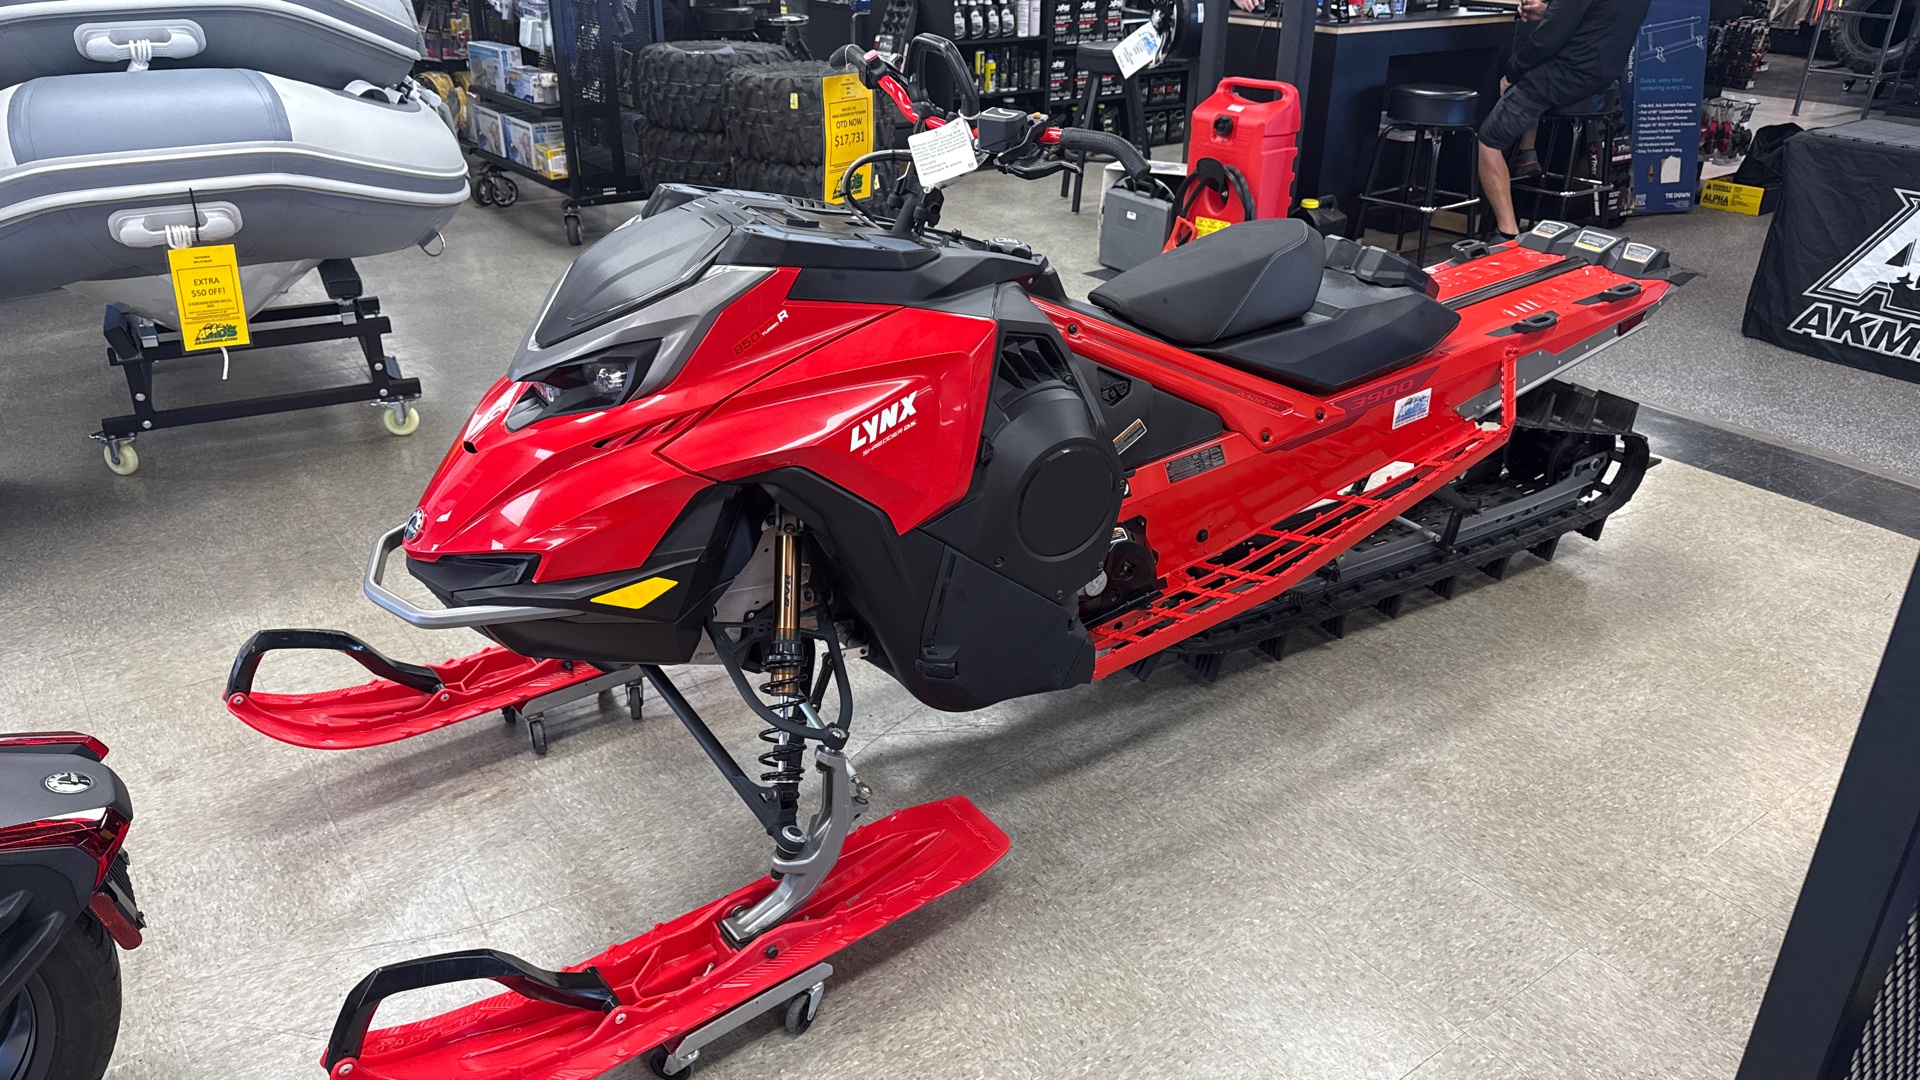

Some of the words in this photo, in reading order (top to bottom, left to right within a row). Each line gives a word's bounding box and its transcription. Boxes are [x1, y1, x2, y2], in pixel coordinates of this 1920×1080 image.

[848, 118, 862, 127] NOW
[834, 131, 865, 148] $17,731
[923, 167, 945, 176] Messages
[1703, 193, 1728, 204] ALPHA
[194, 277, 220, 286] EXTRA
[191, 289, 206, 298] $50
[208, 287, 226, 295] OFF!
[733, 331, 760, 356] 850
[762, 322, 779, 336] TURBO
[777, 309, 788, 323] R
[1787, 302, 1920, 364] AKM
[1350, 379, 1414, 410] 3900
[850, 390, 918, 452] LYNX
[862, 428, 903, 456] SHREDDER
